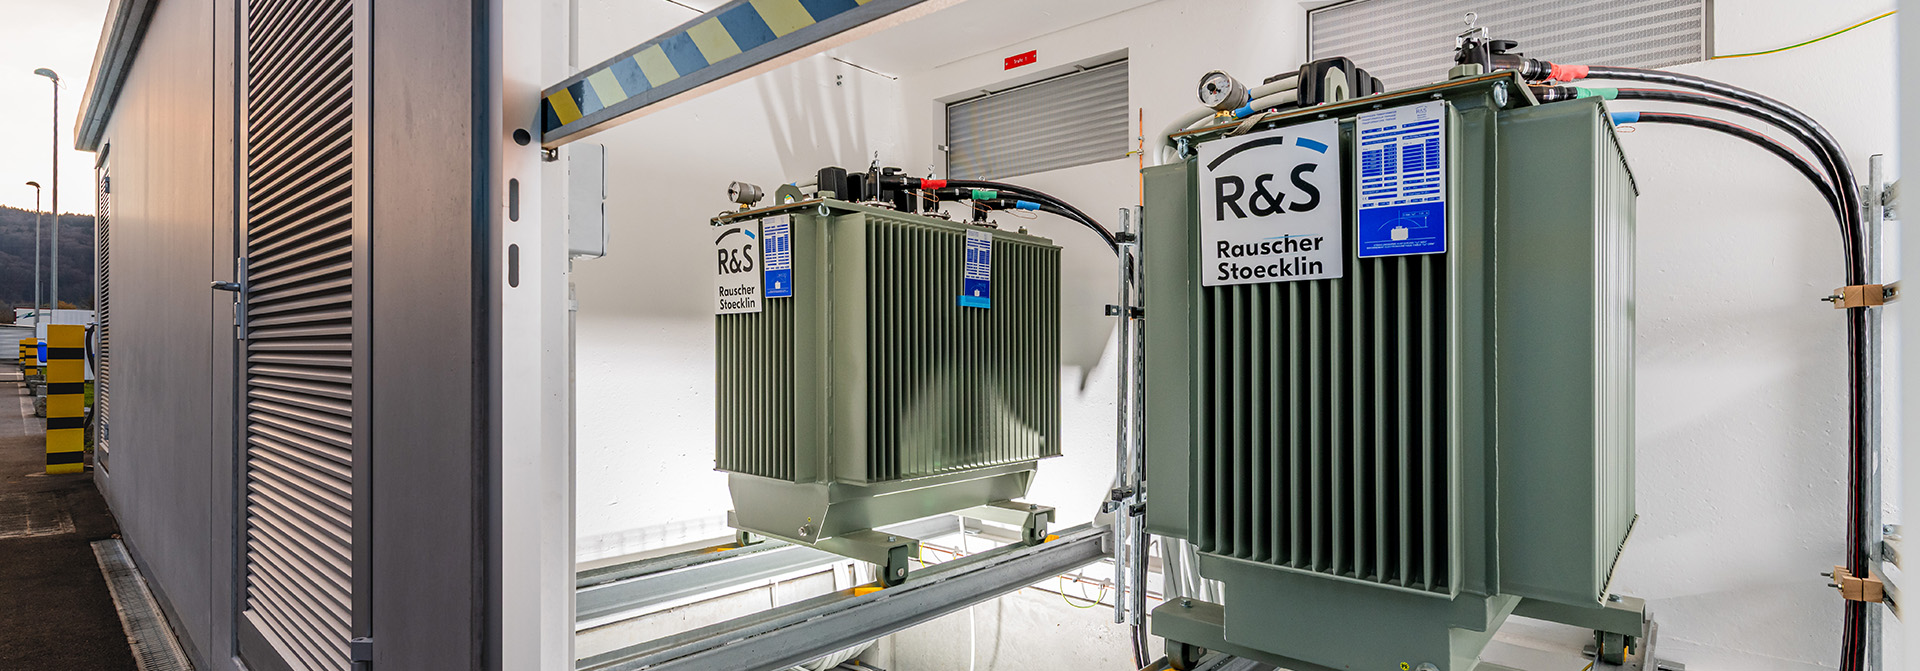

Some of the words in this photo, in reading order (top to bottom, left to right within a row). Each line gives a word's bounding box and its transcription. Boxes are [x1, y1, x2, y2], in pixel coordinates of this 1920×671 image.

[1215, 163, 1321, 221] R&S
[1217, 234, 1323, 258] Rauscher
[718, 244, 753, 275] R&S
[1217, 256, 1323, 280] Stoecklin
[719, 284, 755, 297] Rauscher
[719, 297, 755, 310] Stoecklin
